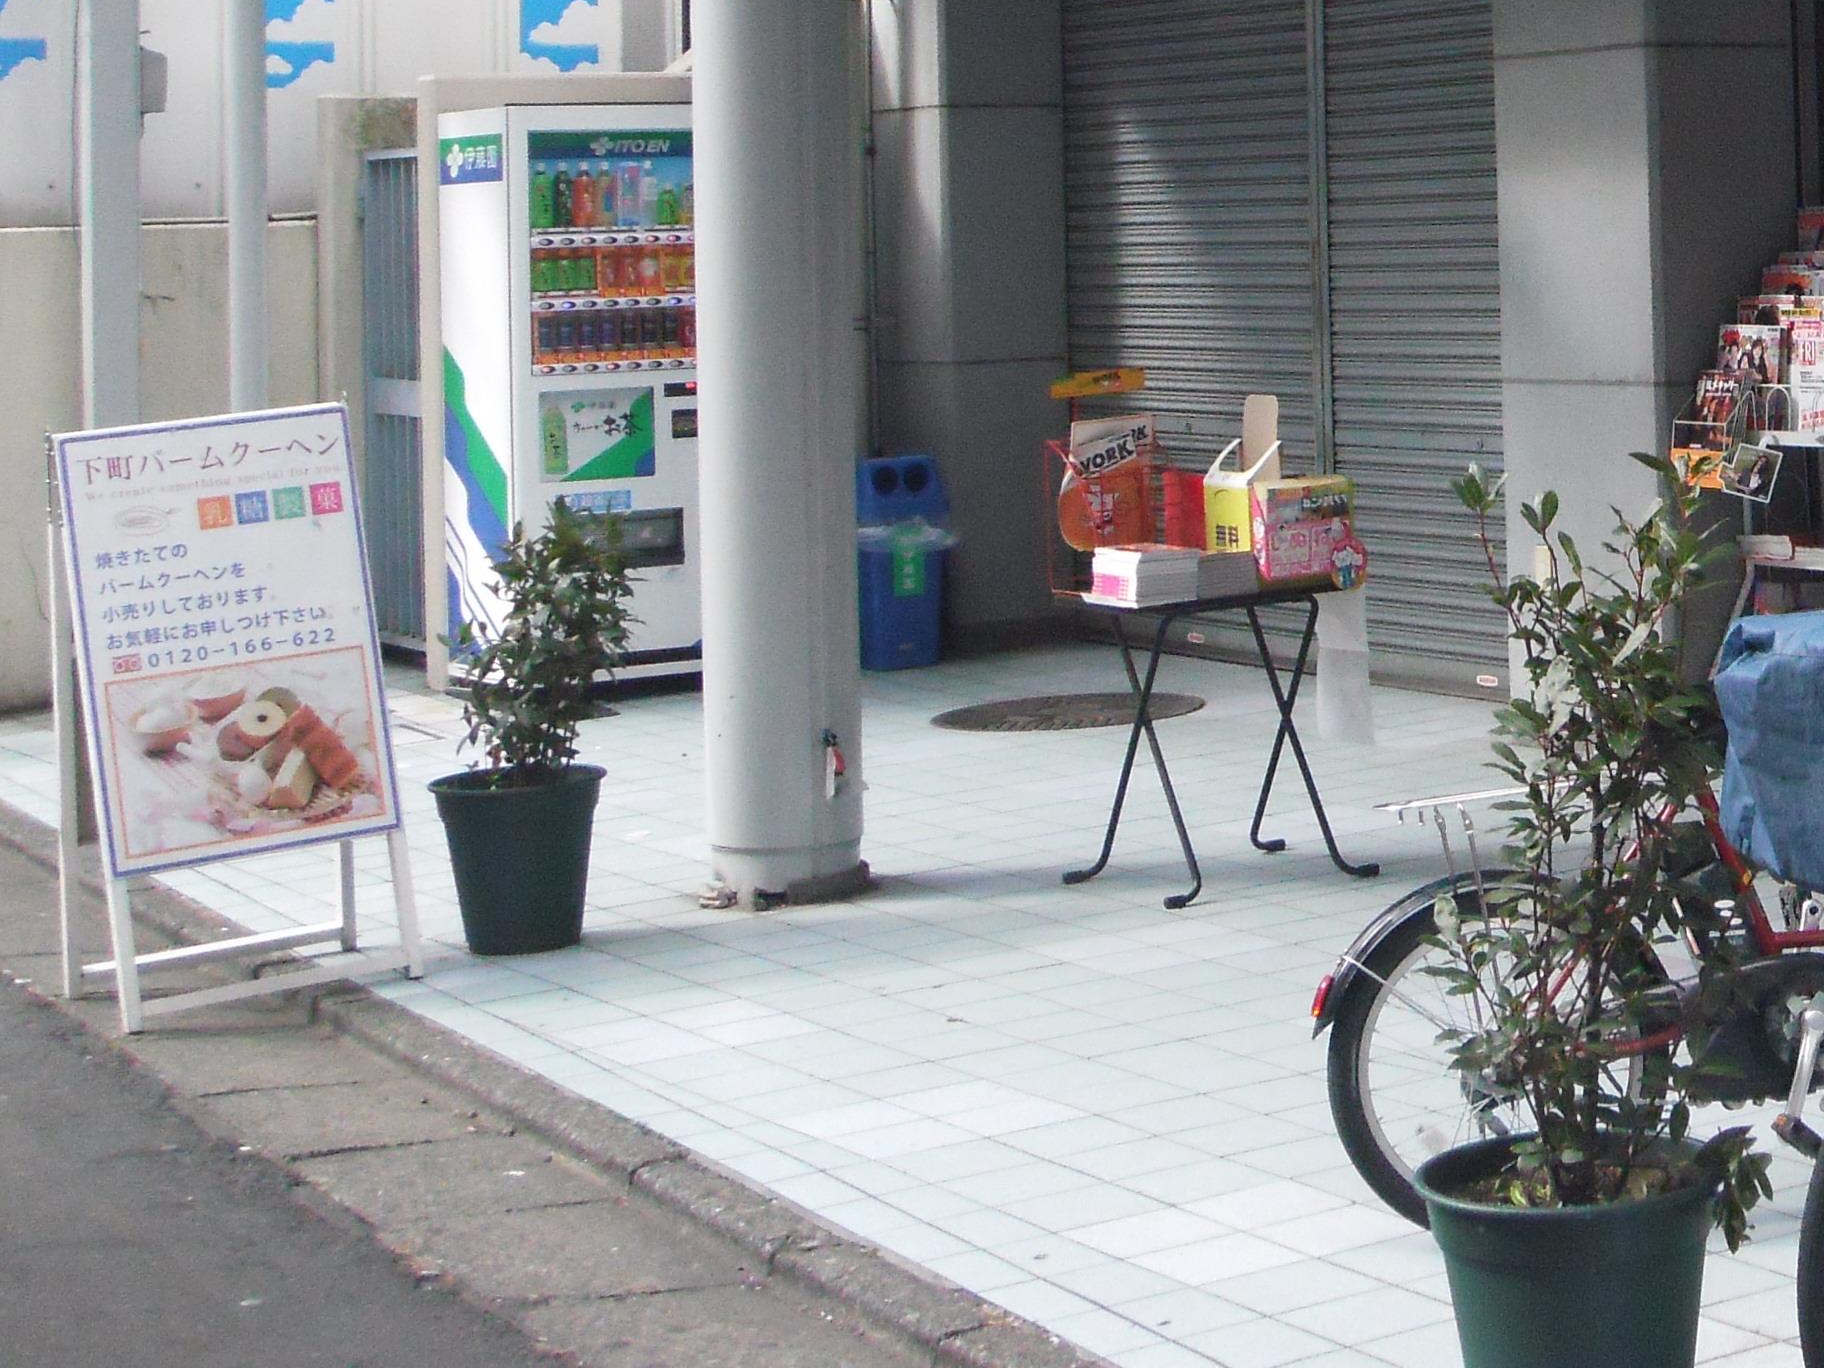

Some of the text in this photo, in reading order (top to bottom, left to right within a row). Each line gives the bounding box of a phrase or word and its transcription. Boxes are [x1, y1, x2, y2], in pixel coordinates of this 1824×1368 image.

[614, 139, 671, 154] ITO EN
[76, 434, 339, 485] 下町バームクーヘン
[95, 543, 188, 570] 焼きたての
[99, 562, 246, 595] バームクーヘンを
[148, 628, 336, 668] 0120-166-622
